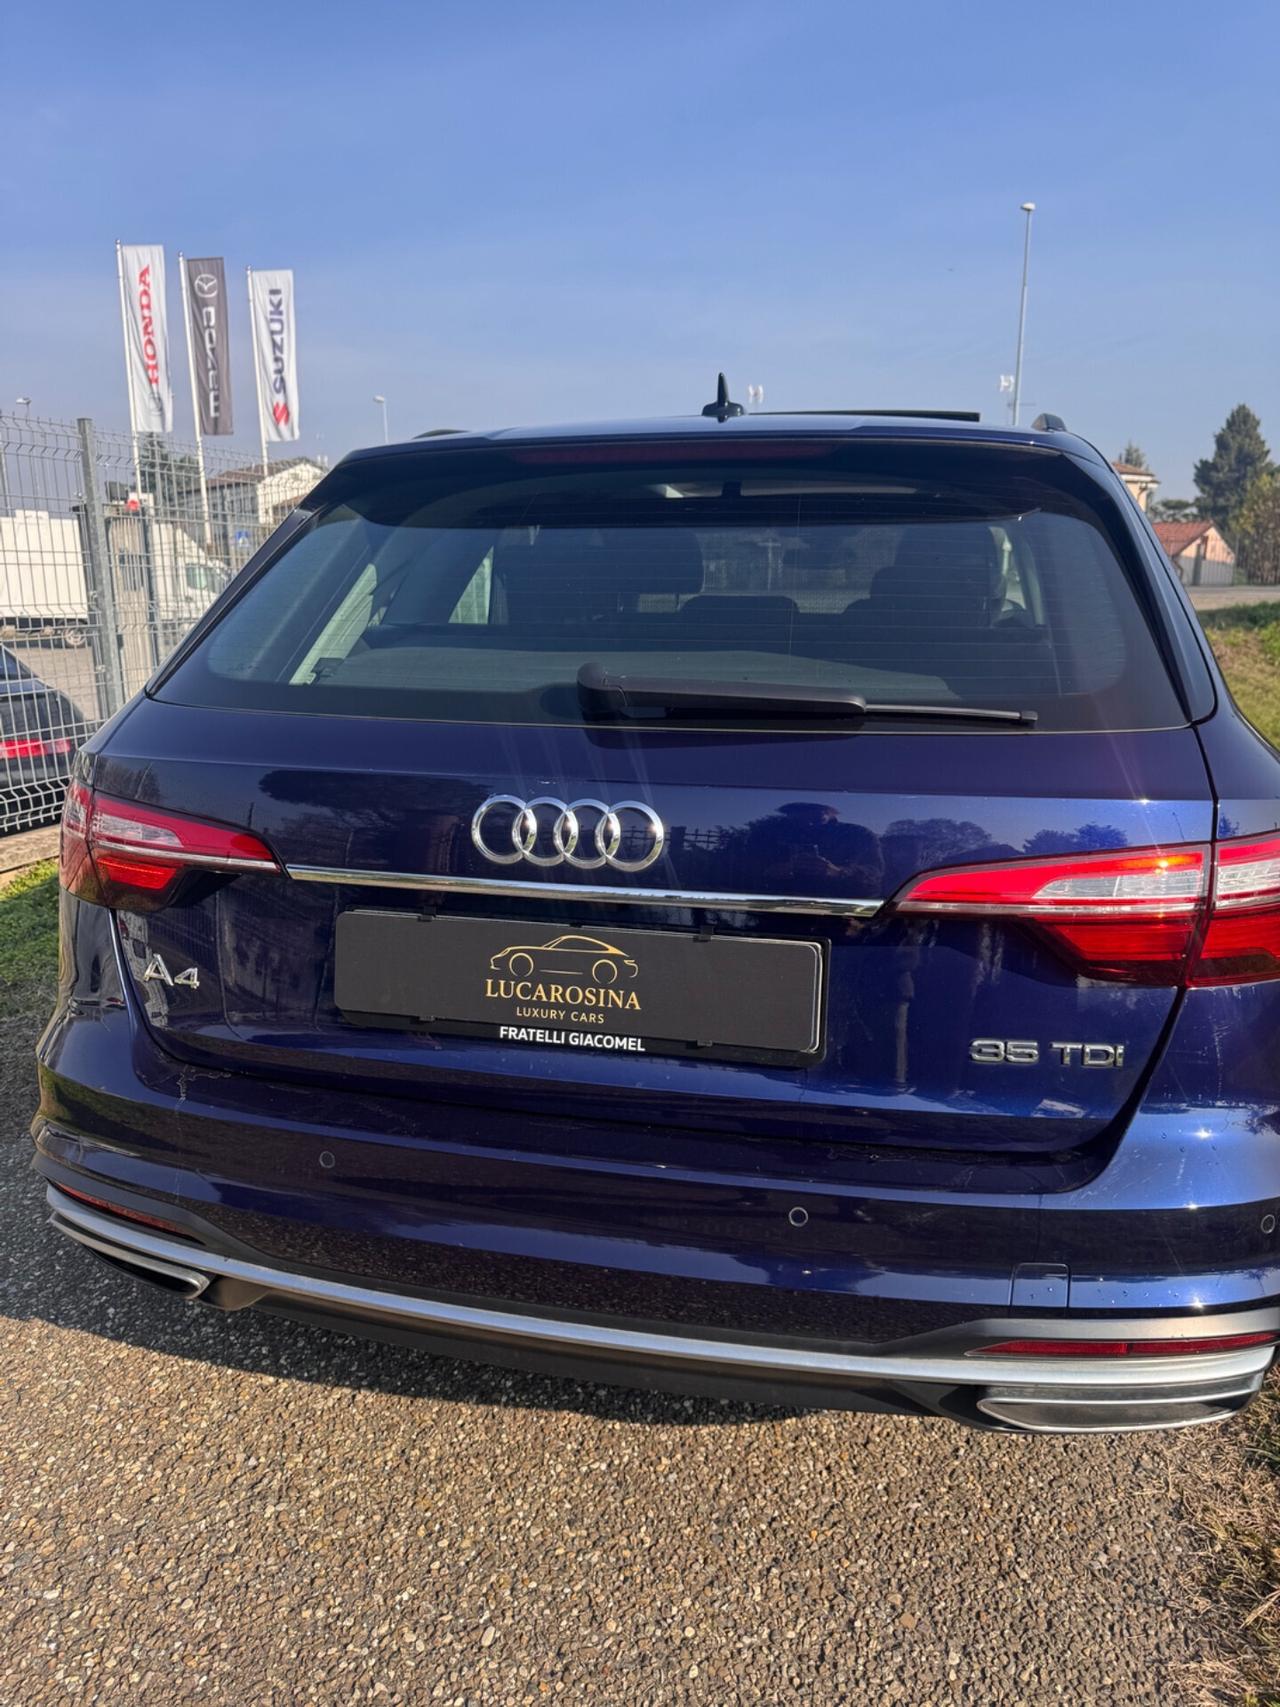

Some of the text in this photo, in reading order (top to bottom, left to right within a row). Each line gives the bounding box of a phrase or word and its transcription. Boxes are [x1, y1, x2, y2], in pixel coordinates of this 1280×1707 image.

[137, 264, 160, 385] HONDA
[268, 288, 287, 394] SUZUKI
[143, 953, 200, 990] A4
[485, 979, 642, 1011] LUCAROSINA
[516, 1006, 605, 1024] LUXURY CARS
[499, 1025, 646, 1052] FRATELLI GIACOMEL
[970, 1039, 1040, 1065] 35
